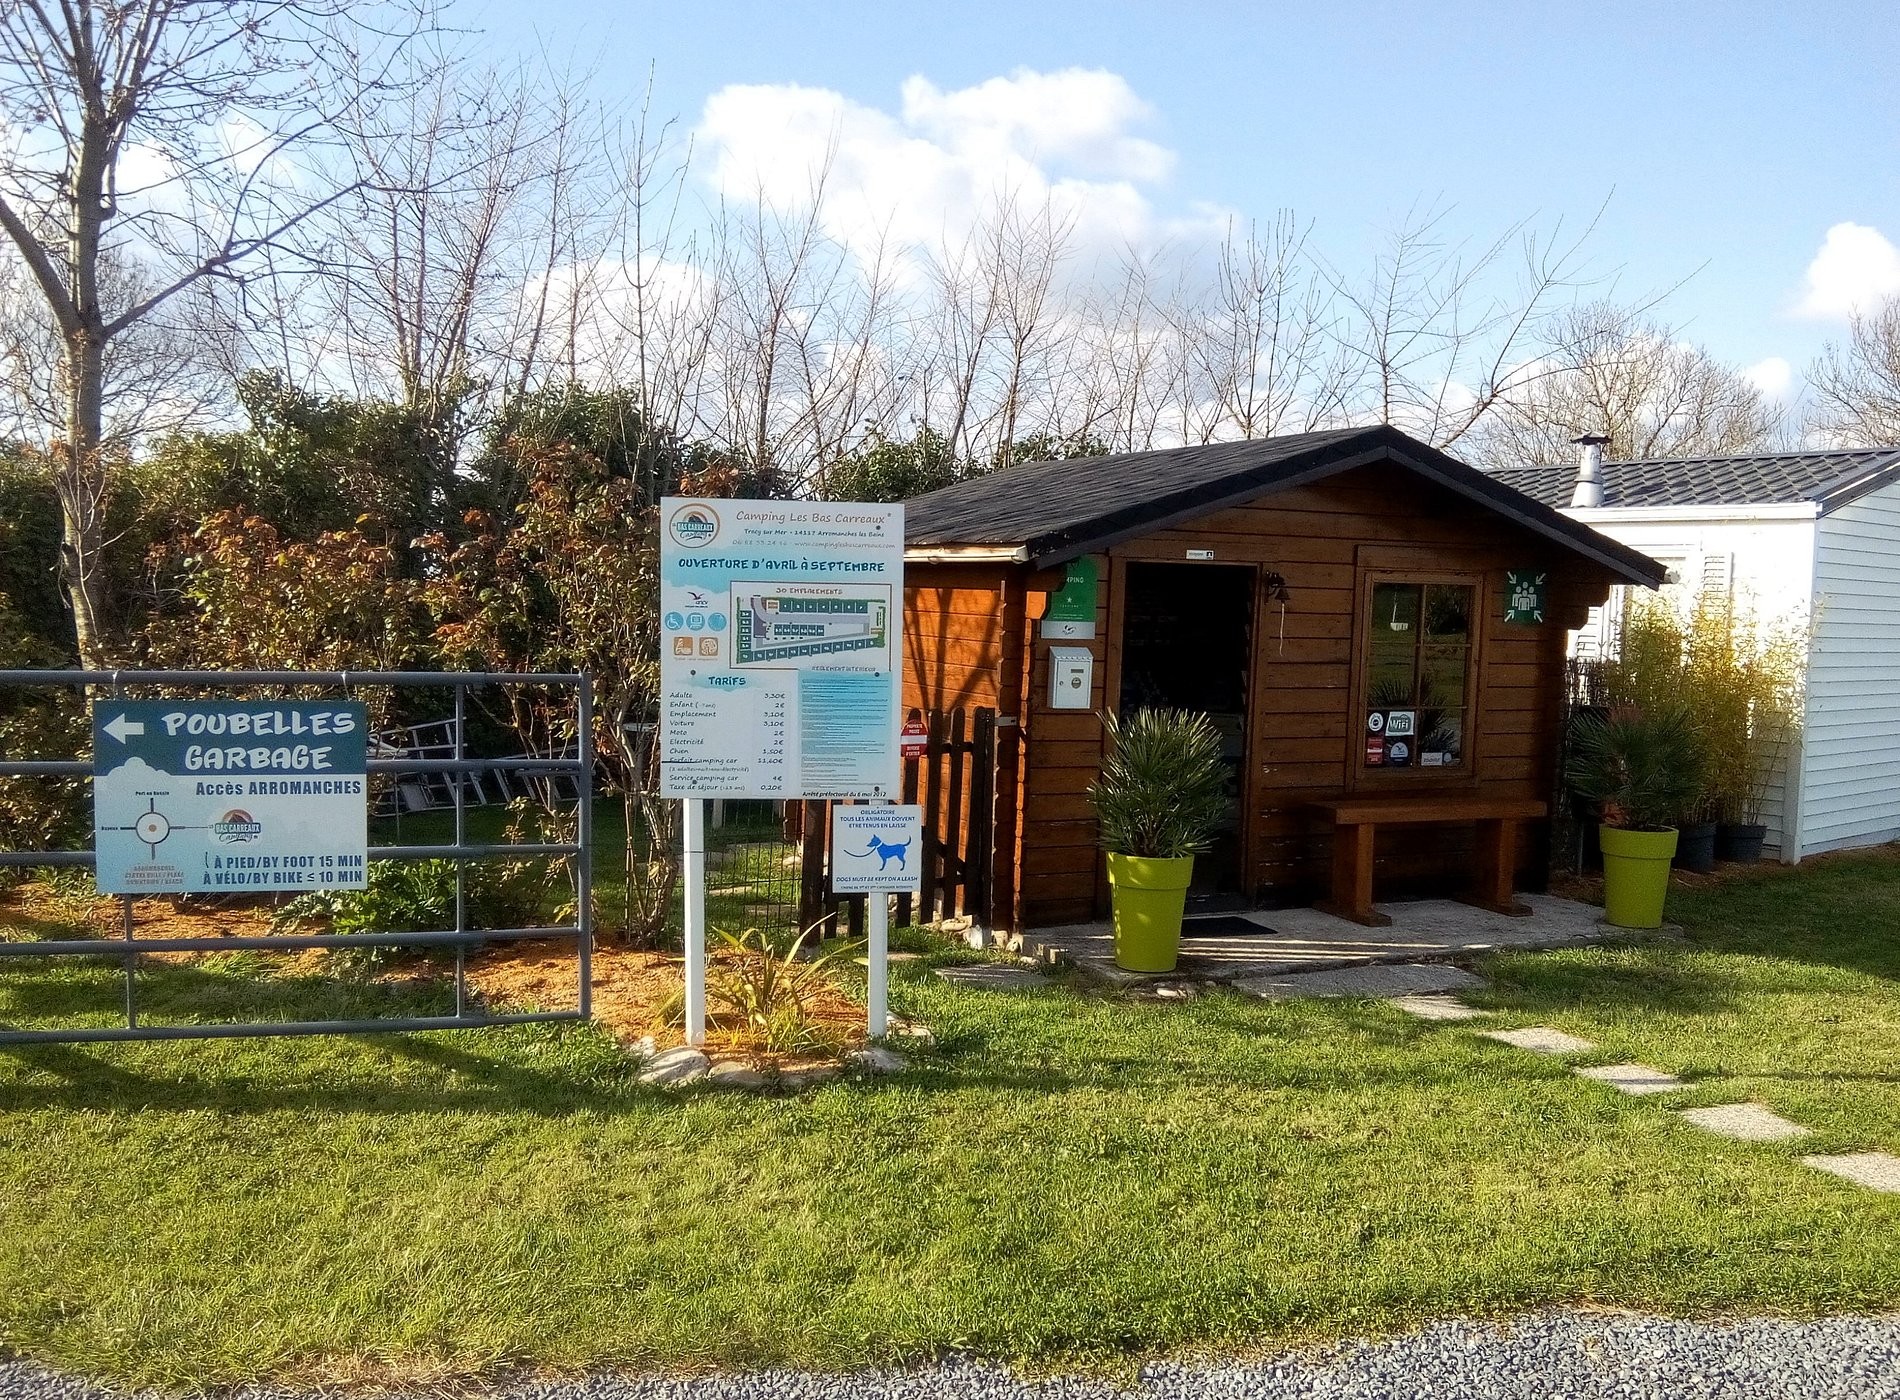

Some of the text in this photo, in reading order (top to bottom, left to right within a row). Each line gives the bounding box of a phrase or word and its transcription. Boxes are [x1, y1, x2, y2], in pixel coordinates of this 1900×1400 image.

[736, 511, 885, 524] Camping Les Bas Carreaux
[679, 557, 885, 572] OUVERTURE D'AVRIL À SEPTEMBRE
[161, 711, 355, 736] POUBELLES
[1390, 720, 1408, 729] WiFi
[185, 745, 332, 770] GARBAGE
[196, 781, 361, 796] Accès ARROMANCHES
[216, 824, 227, 833] BAS
[214, 855, 362, 869] À PIED/BY FOOT 15 MIN
[204, 871, 211, 884] À
[215, 870, 269, 884] VÉLO/BY
[274, 872, 302, 883] BIKE
[319, 872, 333, 883] 10
[338, 871, 362, 882] MIN
